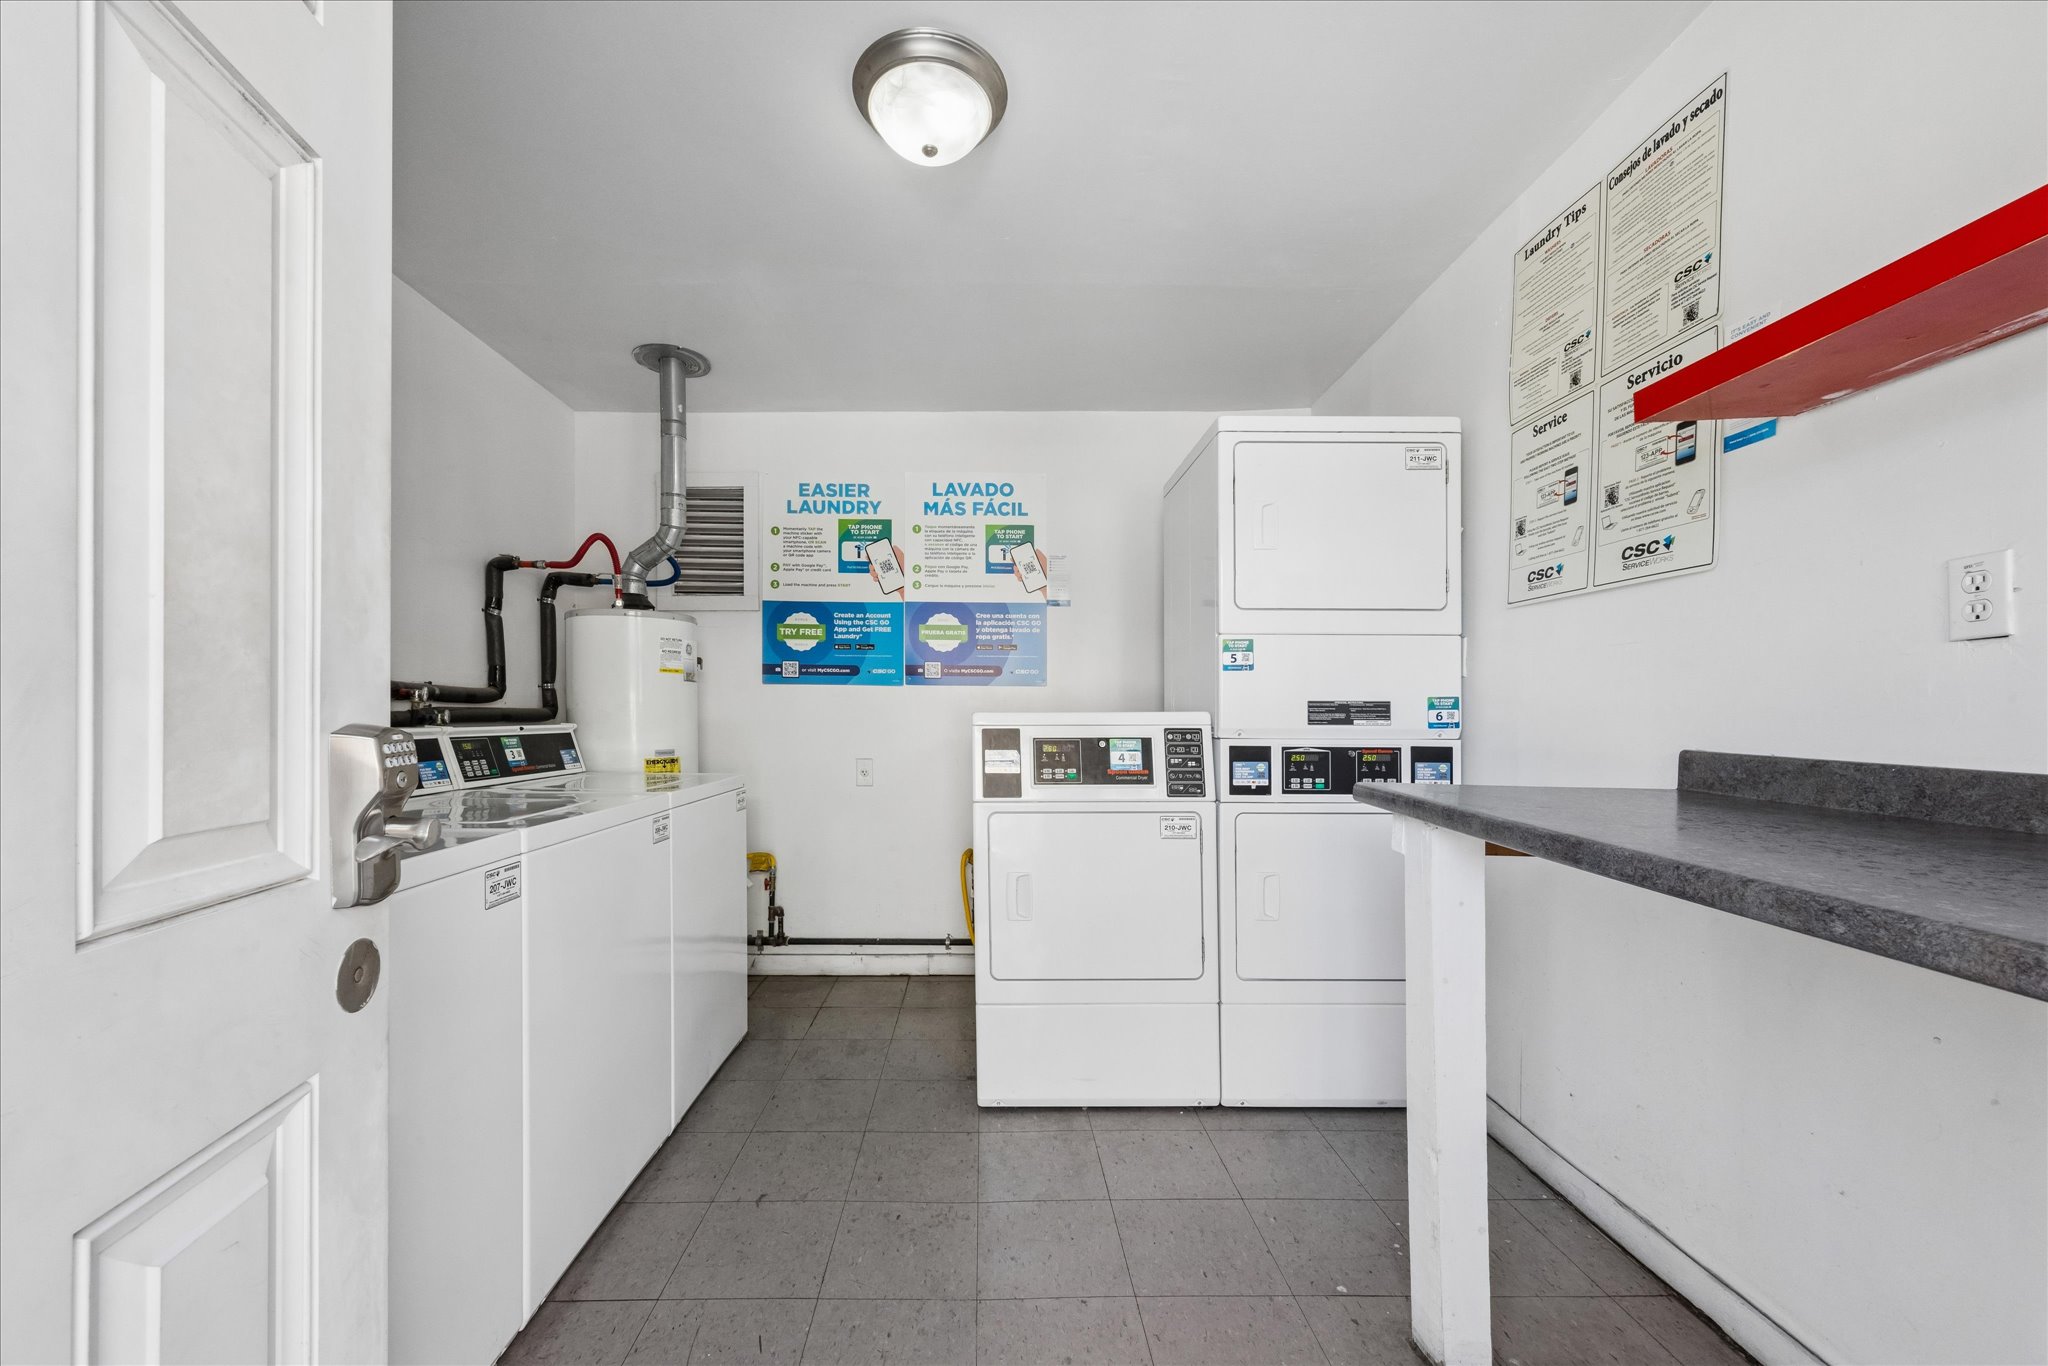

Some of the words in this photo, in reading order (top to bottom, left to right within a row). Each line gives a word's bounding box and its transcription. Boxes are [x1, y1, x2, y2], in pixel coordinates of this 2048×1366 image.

[1608, 157, 1640, 189] Consejos
[1642, 147, 1651, 161] de
[1652, 123, 1680, 152] lavado
[1681, 115, 1688, 131] y
[1690, 88, 1723, 120] secado
[1524, 224, 1562, 260] Laundry
[1563, 204, 1586, 226] Tips
[1643, 230, 1670, 252] SECADORAS
[1674, 259, 1702, 282] CSC
[1730, 318, 1768, 340] CONVENIENT
[1742, 318, 1758, 330] EASY
[1758, 312, 1772, 322] AND
[1563, 334, 1584, 351] CSC
[1626, 354, 1682, 388] Servicio
[1532, 413, 1567, 436] Service
[799, 482, 870, 498] EASIER
[932, 482, 1014, 498] LAVADO
[786, 500, 882, 516] LAUNDRY
[924, 498, 966, 517] MÁS
[972, 498, 1028, 517] FÁCIL
[1621, 540, 1660, 559] CSC
[1527, 566, 1554, 582] CSC
[1230, 654, 1237, 663] 5
[1436, 712, 1443, 721] 6
[510, 750, 515, 759] 3
[1118, 753, 1125, 763] 4
[489, 877, 517, 894] 207-JWC
